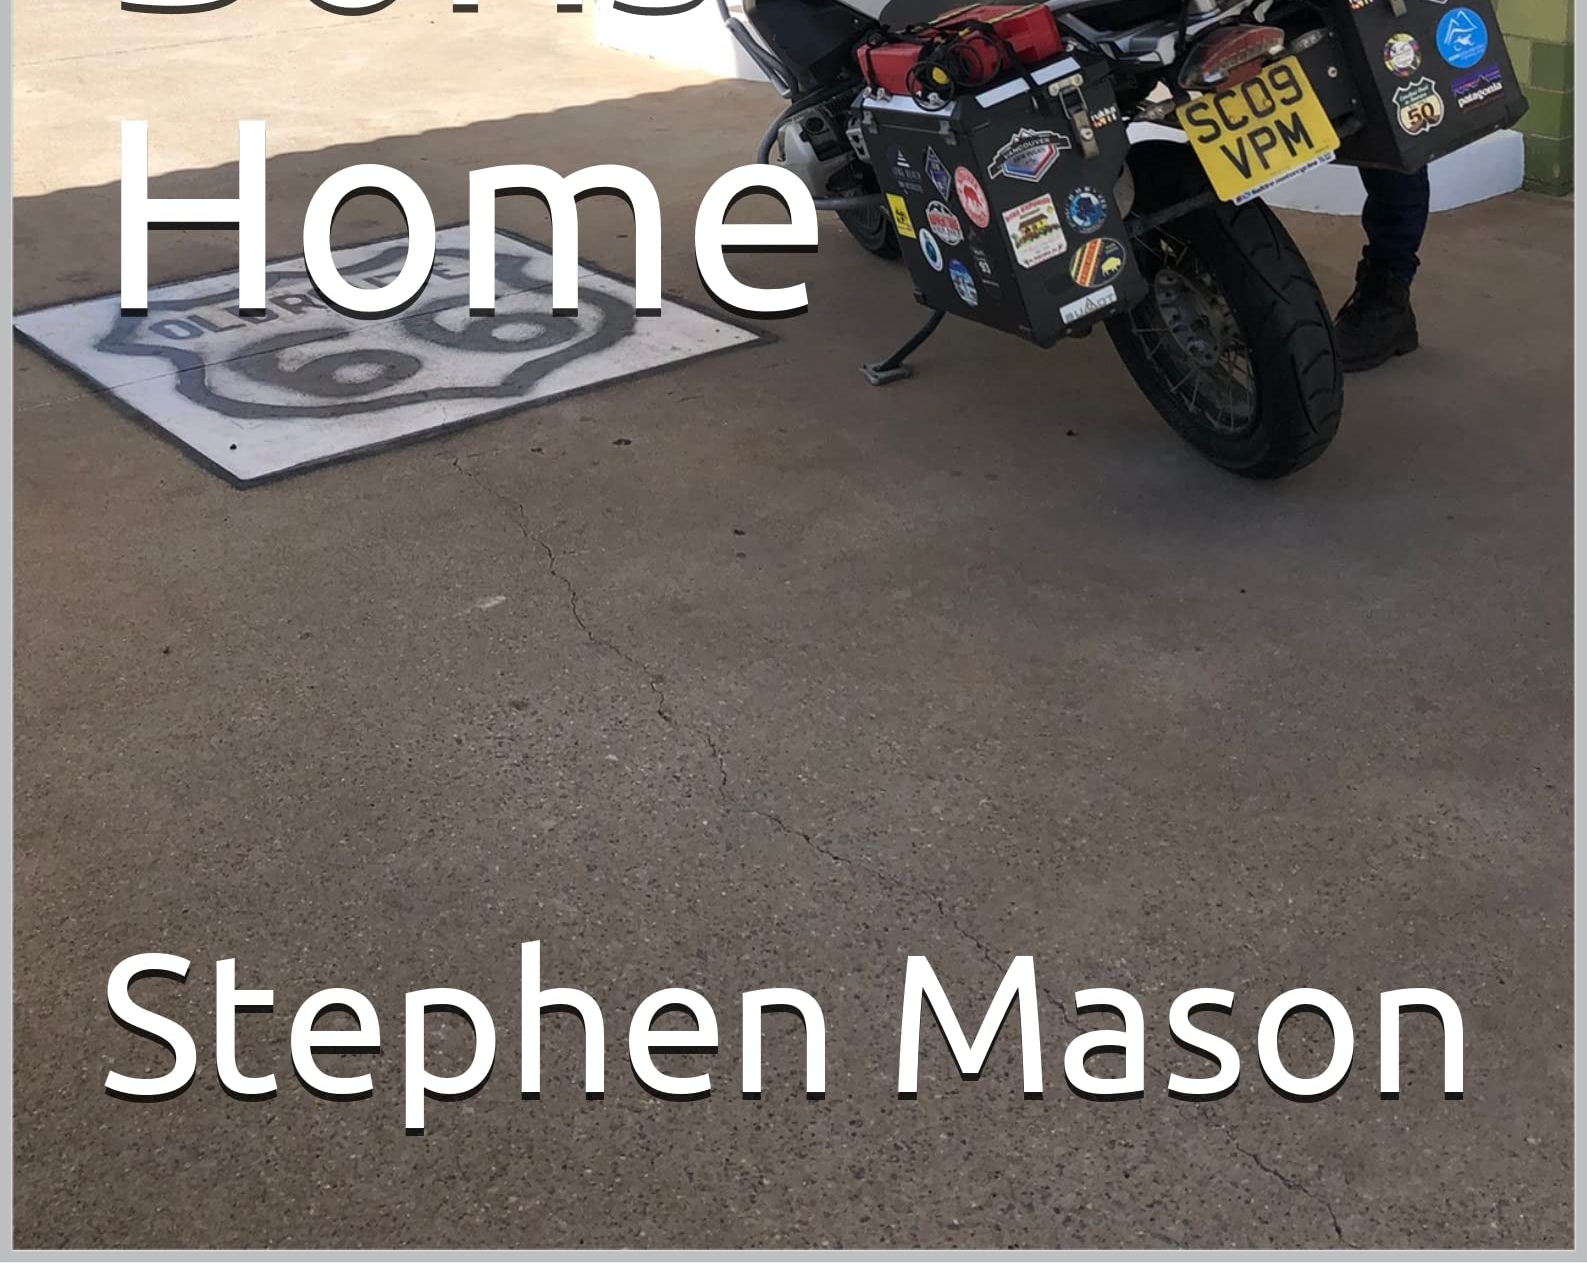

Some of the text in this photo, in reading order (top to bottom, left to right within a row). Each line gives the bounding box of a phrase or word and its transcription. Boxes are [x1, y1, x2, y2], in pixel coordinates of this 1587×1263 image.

[1185, 64, 1304, 145] SC09
[1407, 101, 1436, 126] 50
[1457, 81, 1504, 109] patagonia
[1001, 135, 1052, 160] VANCOUVER
[1220, 111, 1315, 180] VPM
[227, 293, 579, 398] 66
